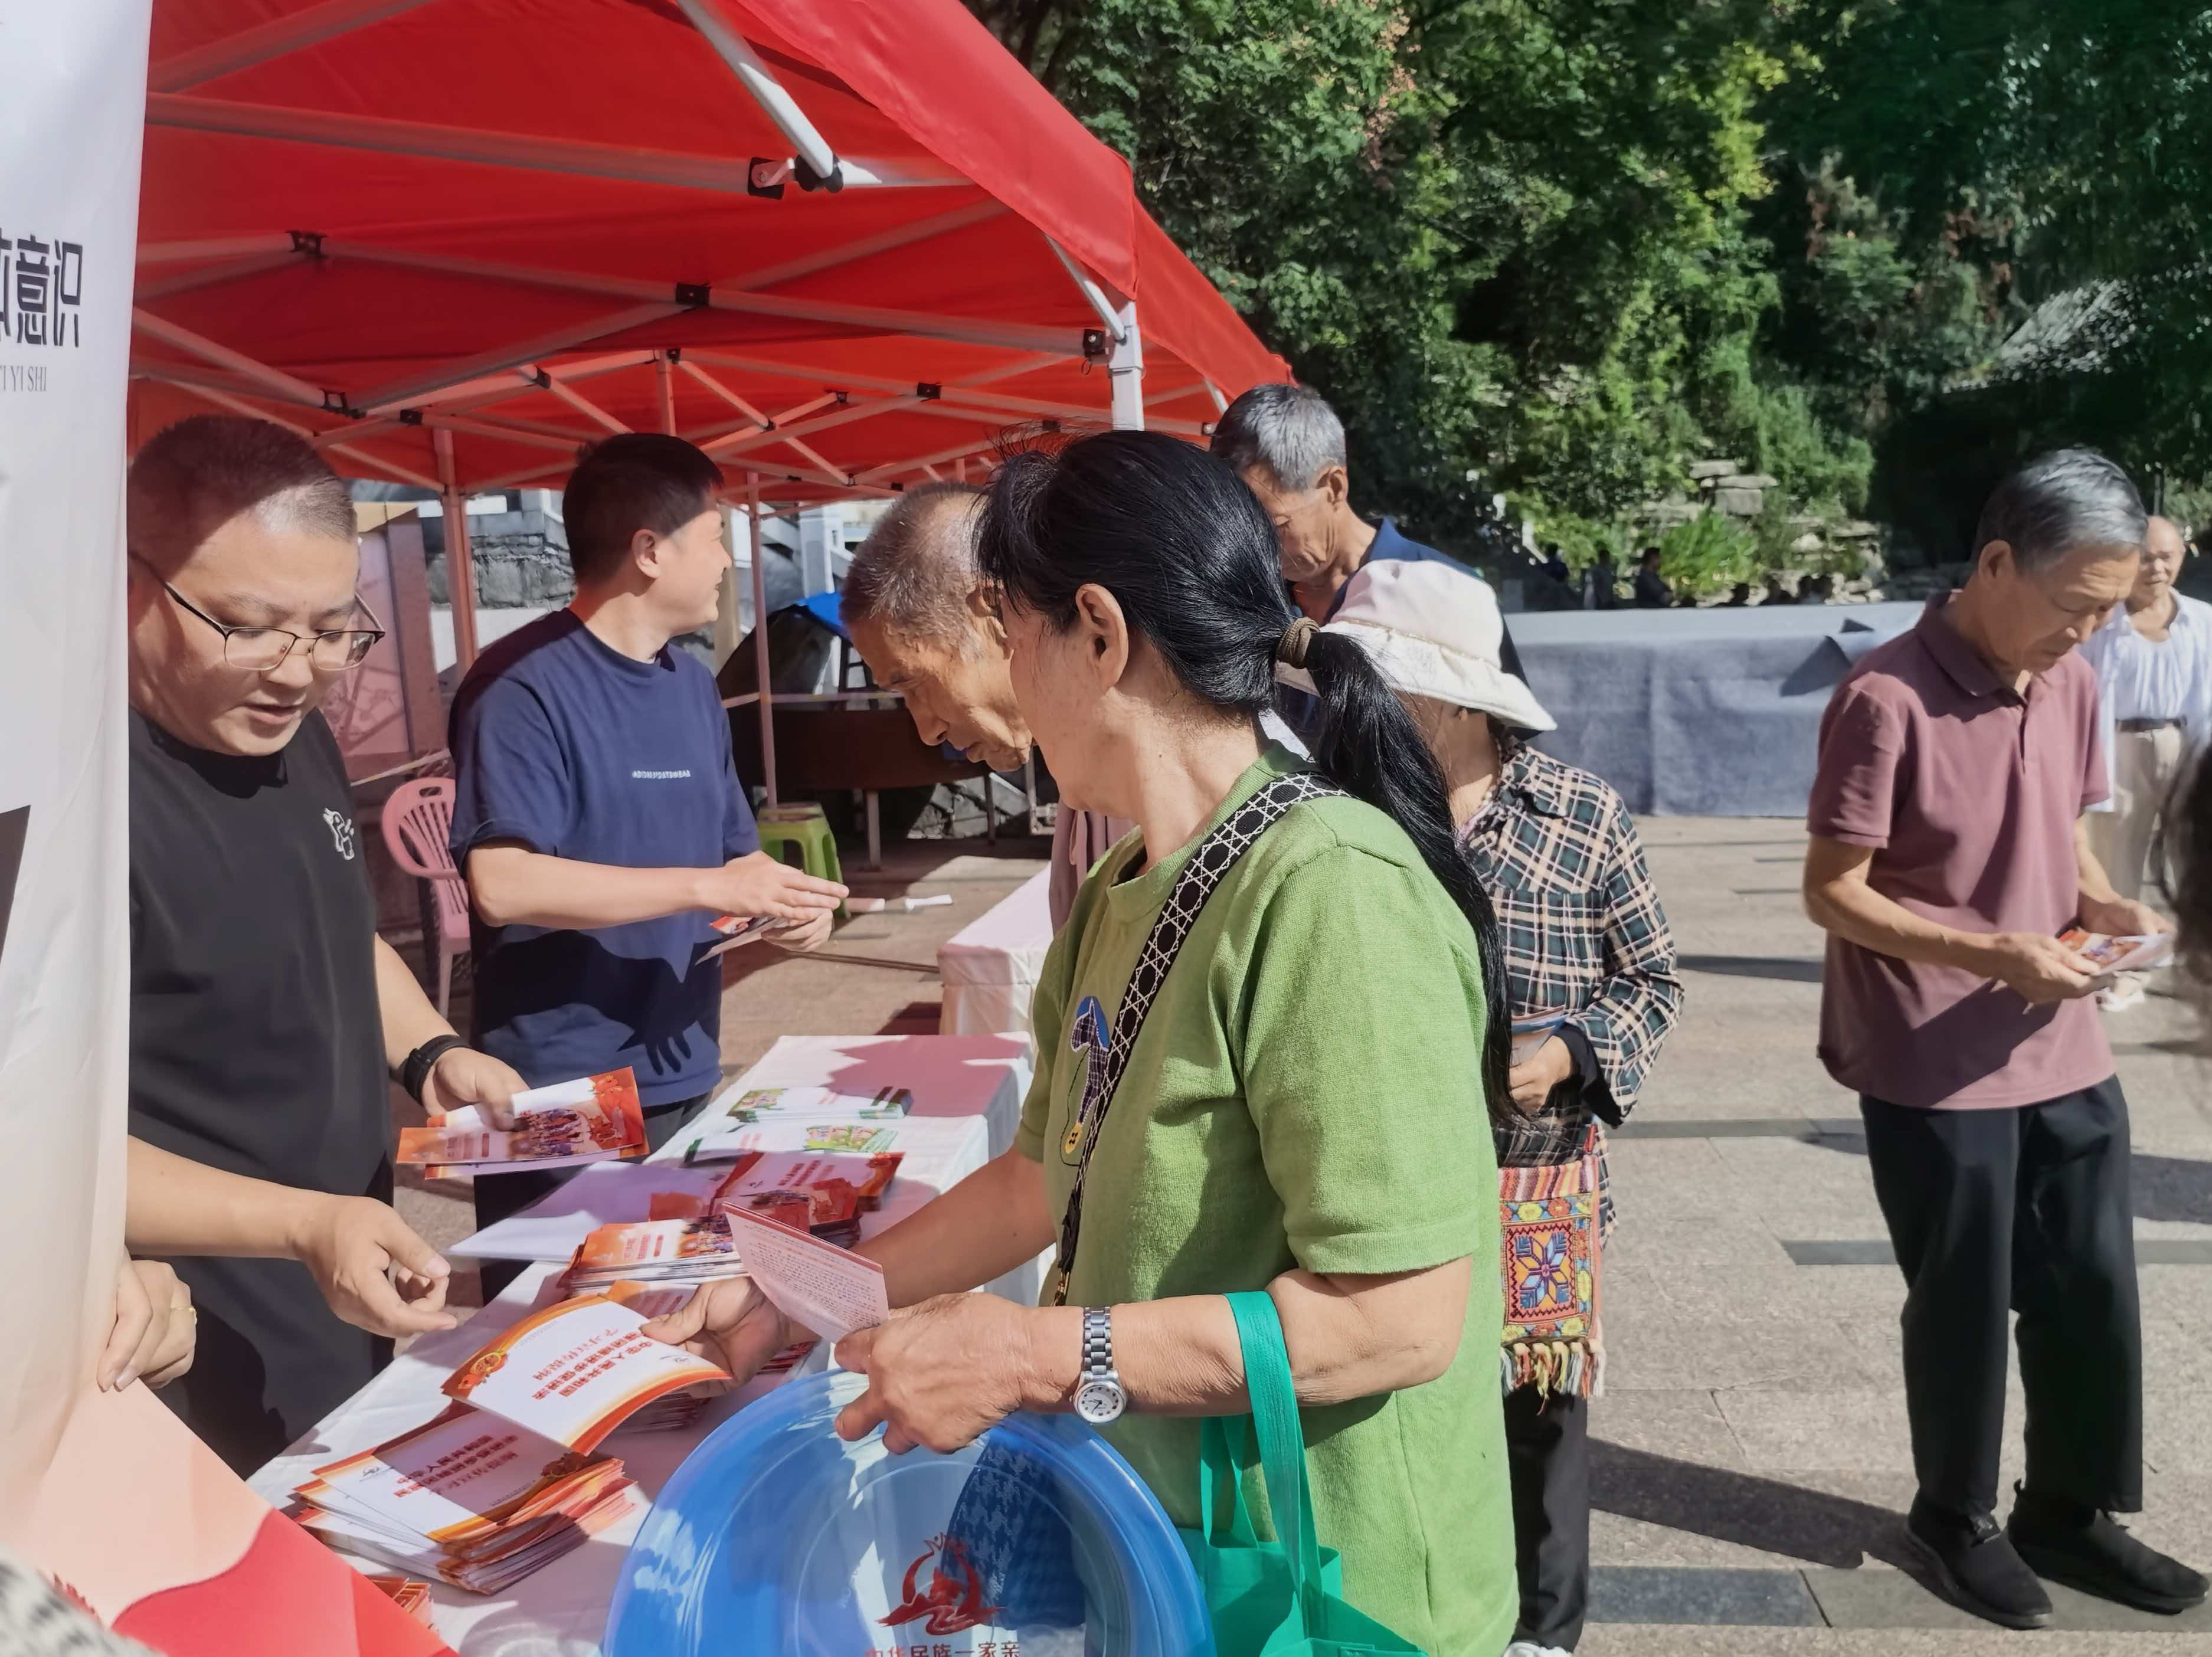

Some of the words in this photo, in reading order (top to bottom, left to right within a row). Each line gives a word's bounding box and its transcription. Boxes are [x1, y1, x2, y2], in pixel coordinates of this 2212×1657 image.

[11, 365, 24, 391] YI
[28, 366, 47, 392] SHI
[531, 1331, 642, 1400] 族团结进步促进法
